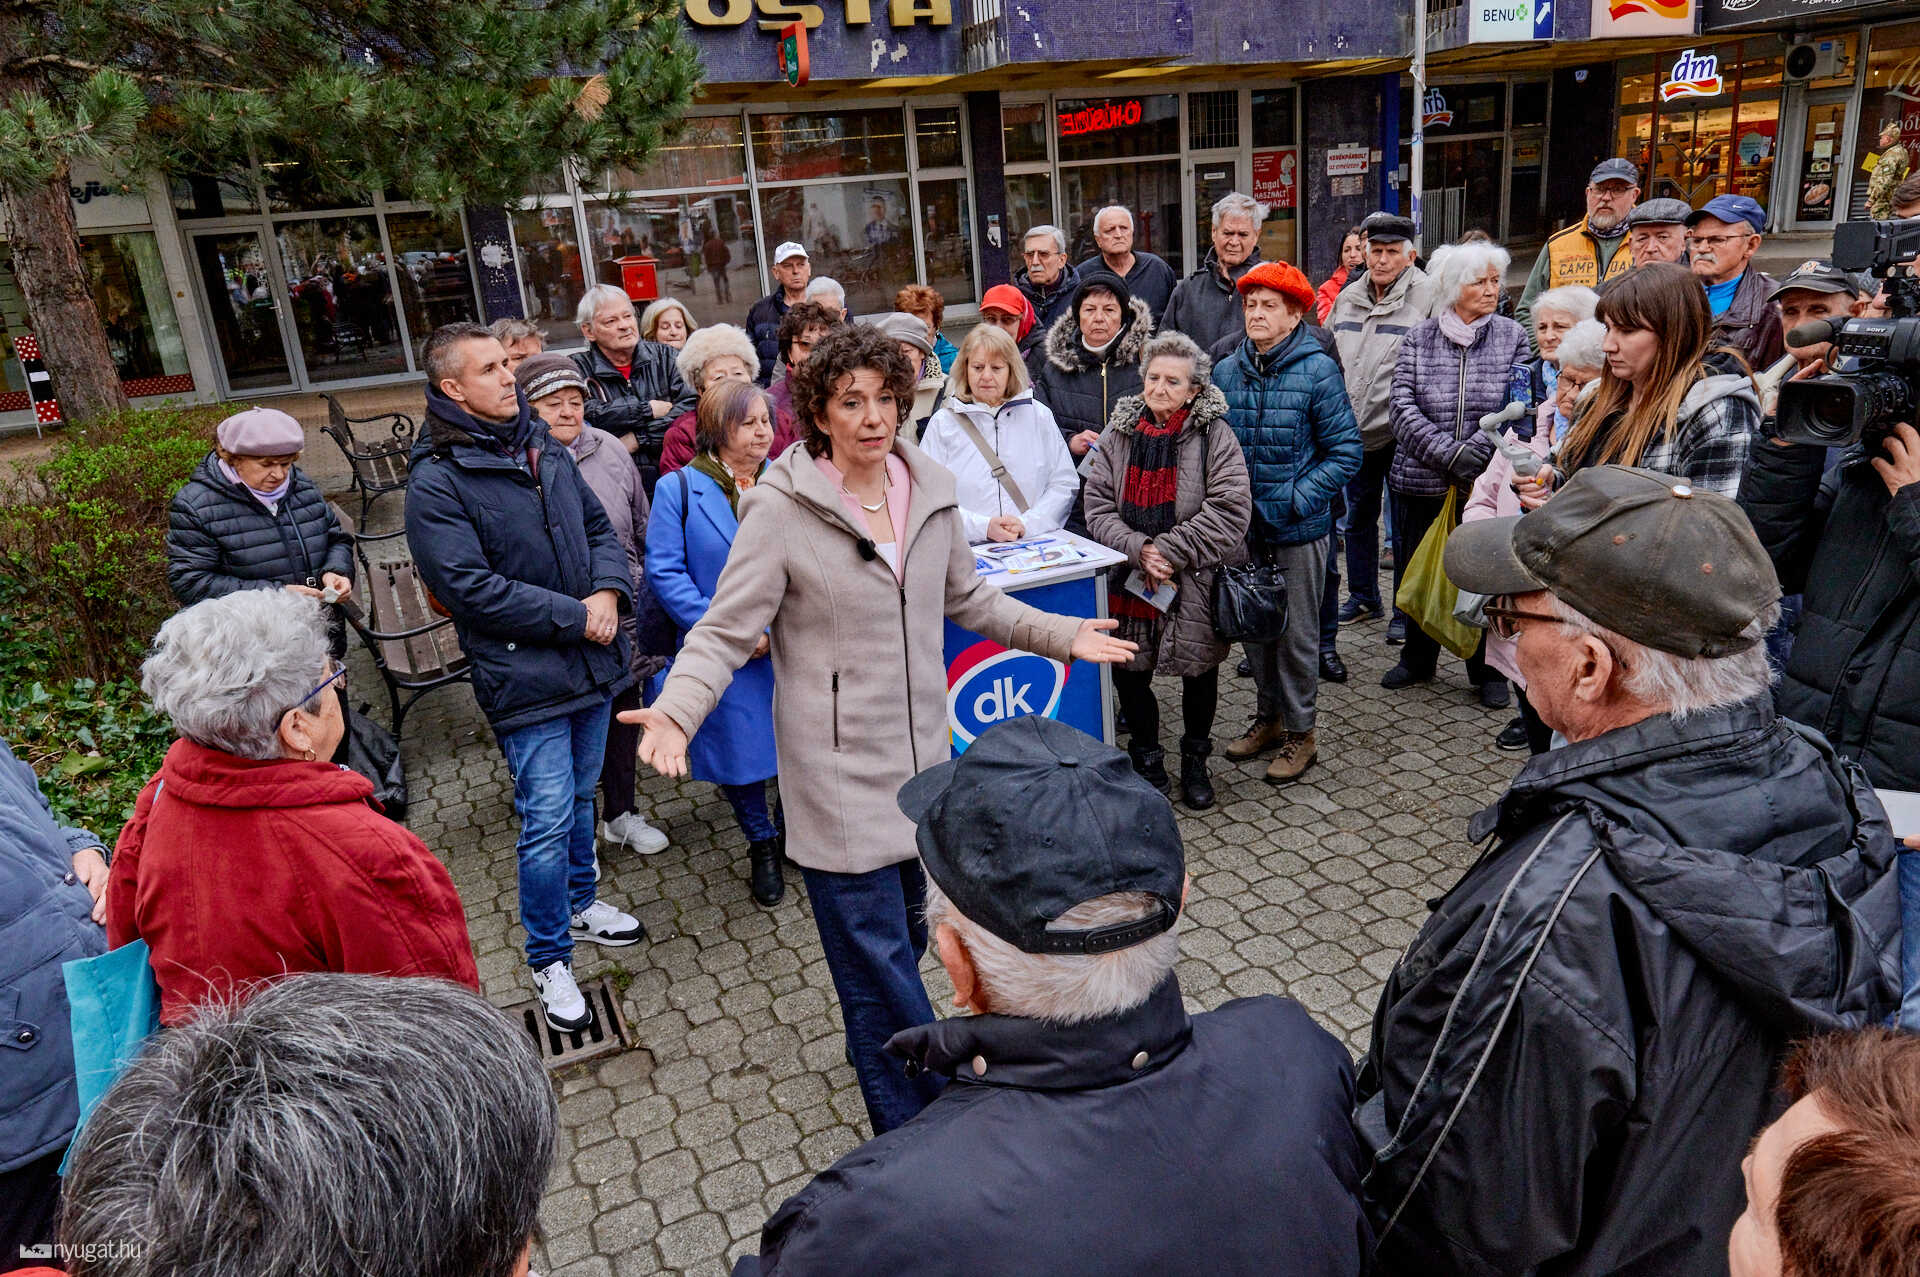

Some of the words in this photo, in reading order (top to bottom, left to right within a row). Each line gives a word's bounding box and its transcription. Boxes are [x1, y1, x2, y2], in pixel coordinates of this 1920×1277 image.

[1483, 9, 1515, 22] BENU
[1674, 53, 1714, 82] dm
[1254, 178, 1280, 191] Angol
[1559, 261, 1594, 276] CAMP
[974, 676, 1034, 723] dk
